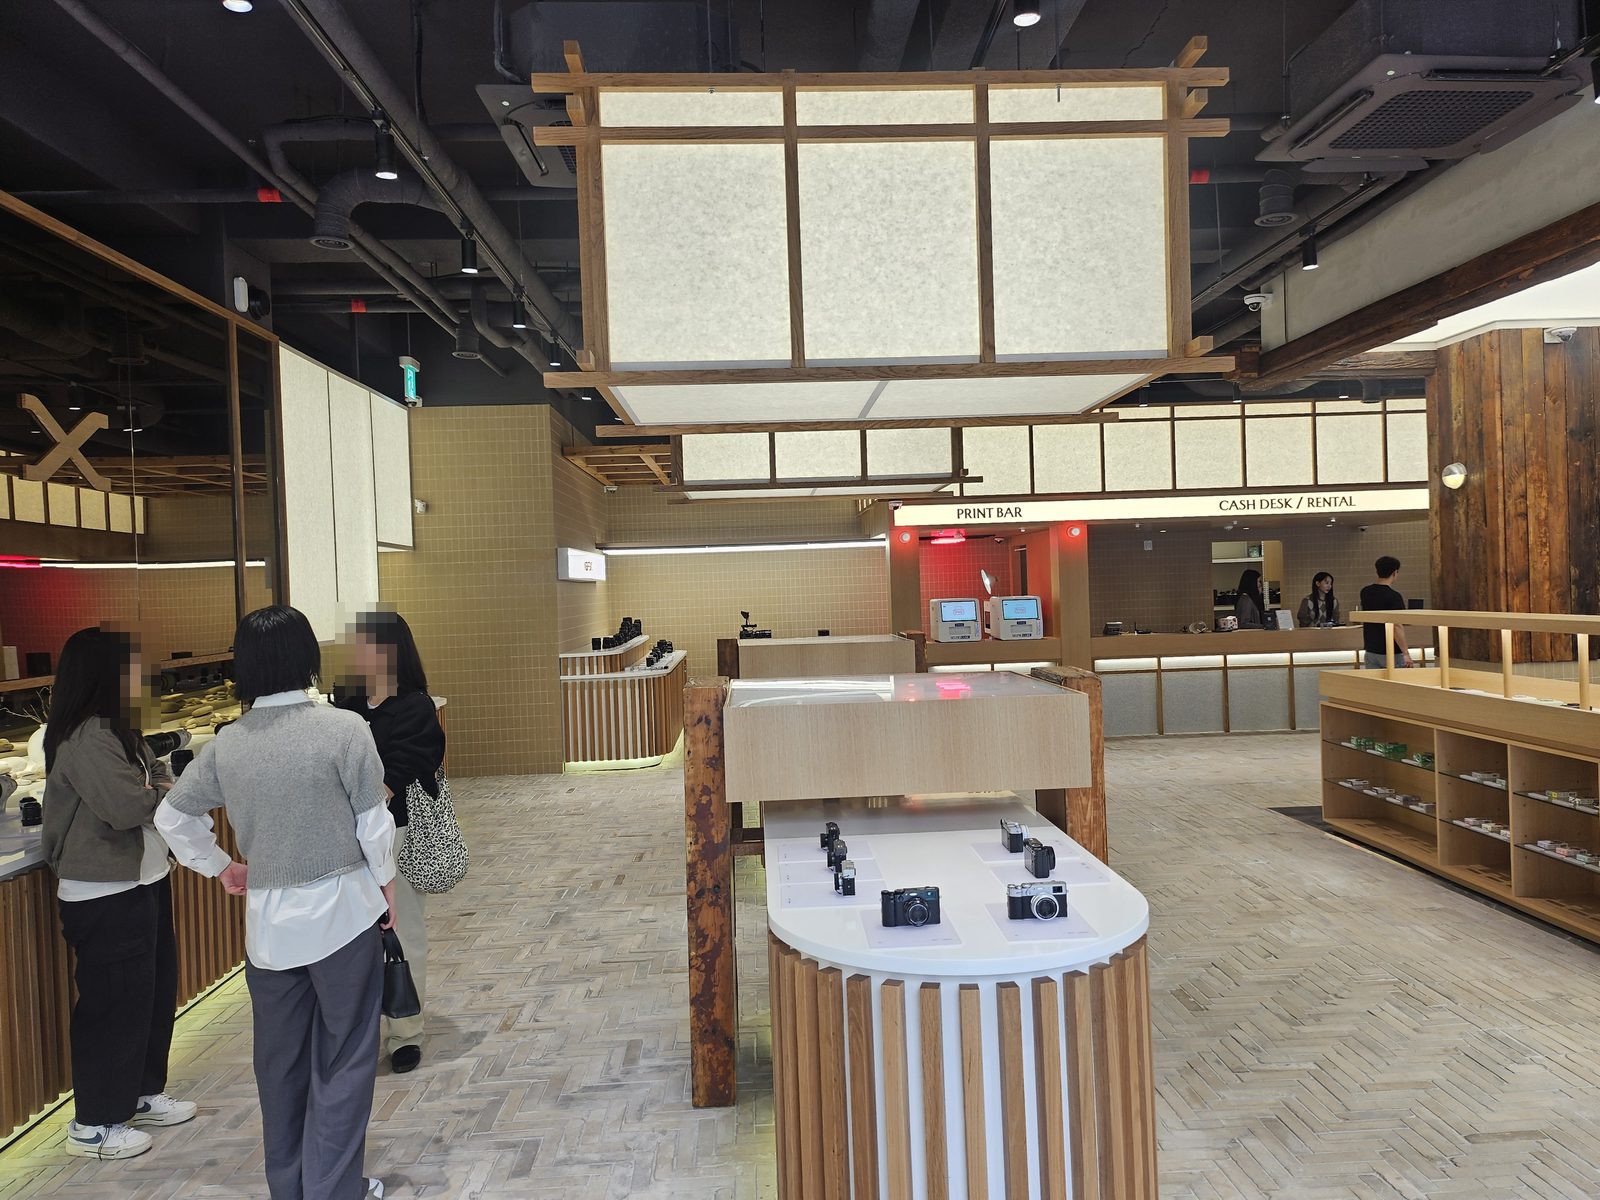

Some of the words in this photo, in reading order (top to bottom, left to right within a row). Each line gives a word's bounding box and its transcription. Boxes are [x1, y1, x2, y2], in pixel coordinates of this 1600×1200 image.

[1219, 499, 1256, 511] CASH
[1260, 497, 1293, 509] DESK
[1296, 496, 1303, 509] /
[1307, 495, 1356, 508] RENTAL
[957, 507, 994, 519] PRINT
[996, 506, 1023, 518] BAR
